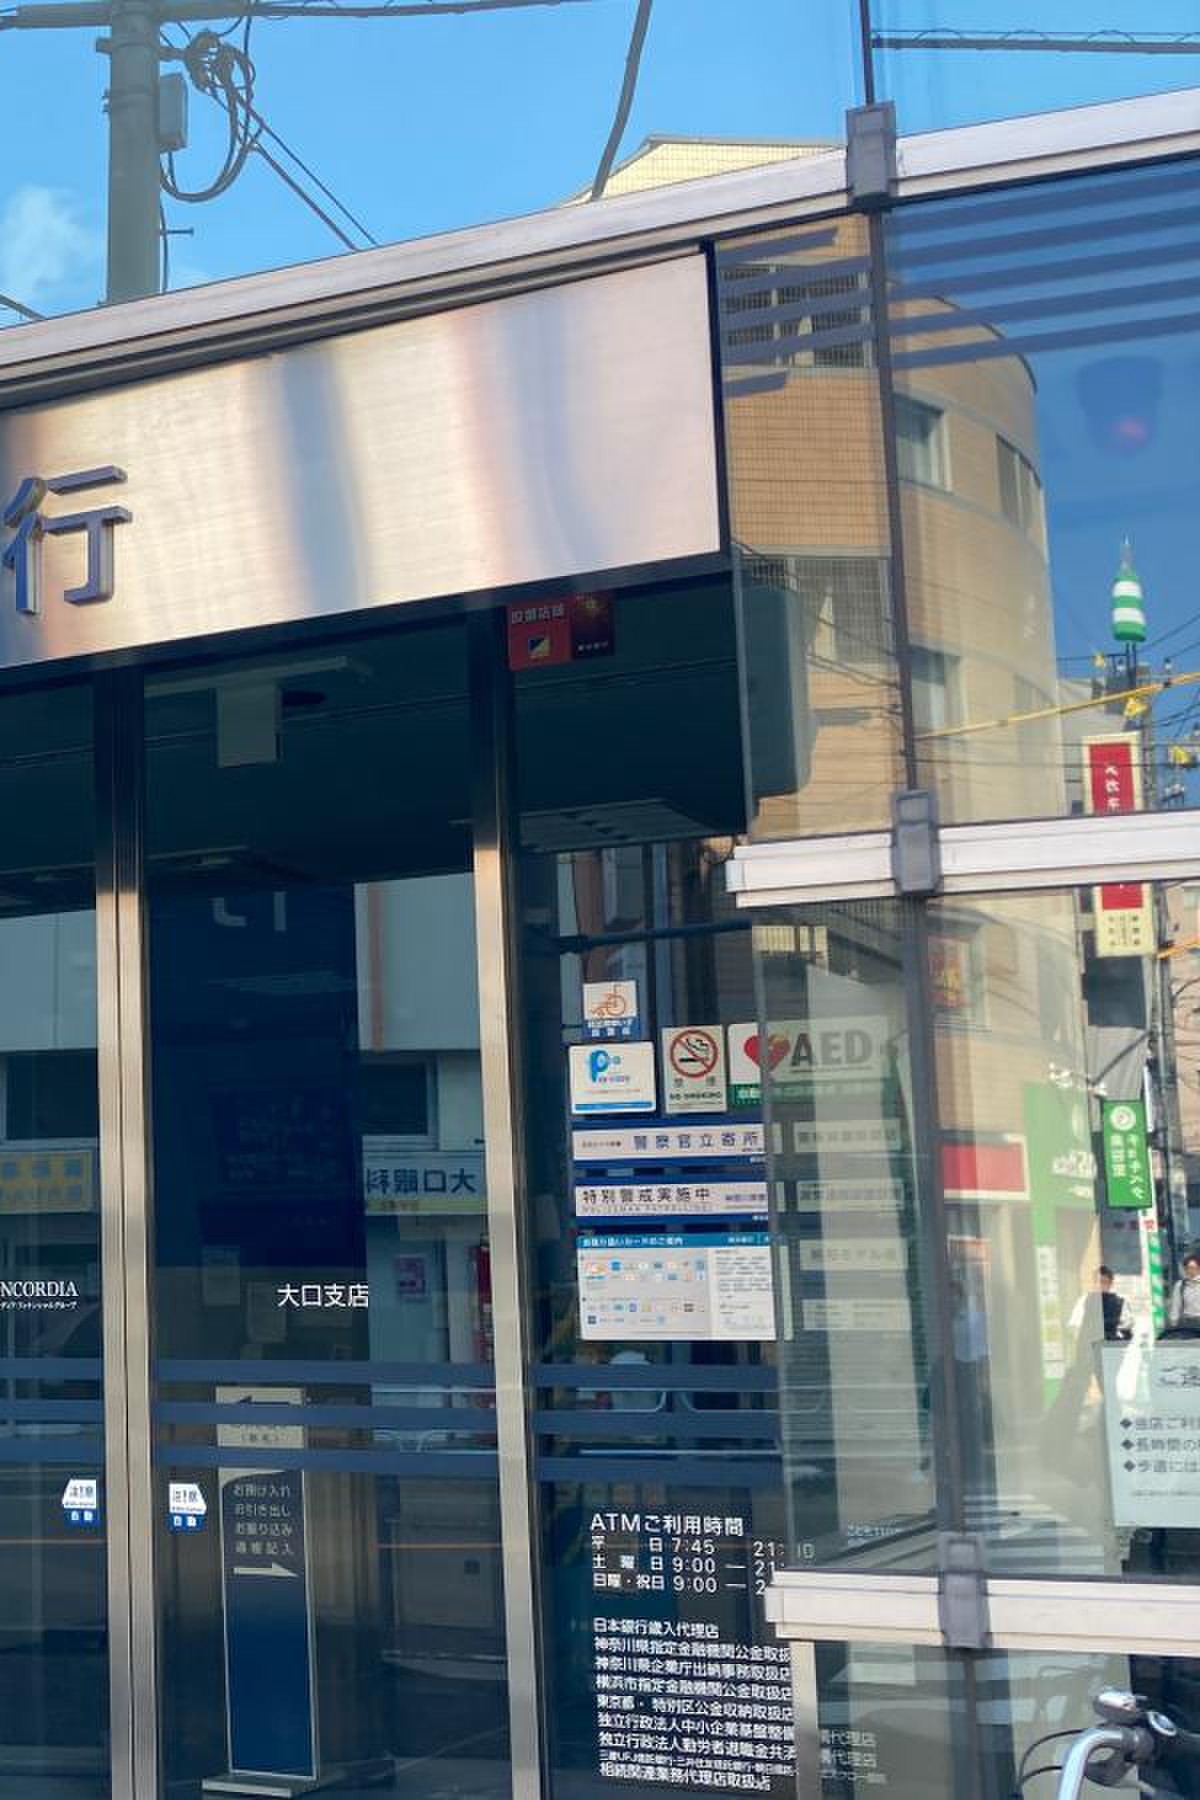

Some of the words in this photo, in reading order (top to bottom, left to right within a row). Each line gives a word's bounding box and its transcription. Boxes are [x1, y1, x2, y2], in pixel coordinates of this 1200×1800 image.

[791, 1030, 873, 1067] AED
[633, 1132, 758, 1150] 警察官立寄所
[582, 1187, 711, 1205] 特別警戒実施中
[277, 1283, 369, 1308] 大口支店
[590, 1513, 744, 1537] ATMご利用時間
[671, 1537, 715, 1554] 7:45
[672, 1557, 716, 1574] 9:00
[673, 1574, 717, 1592] 9:00
